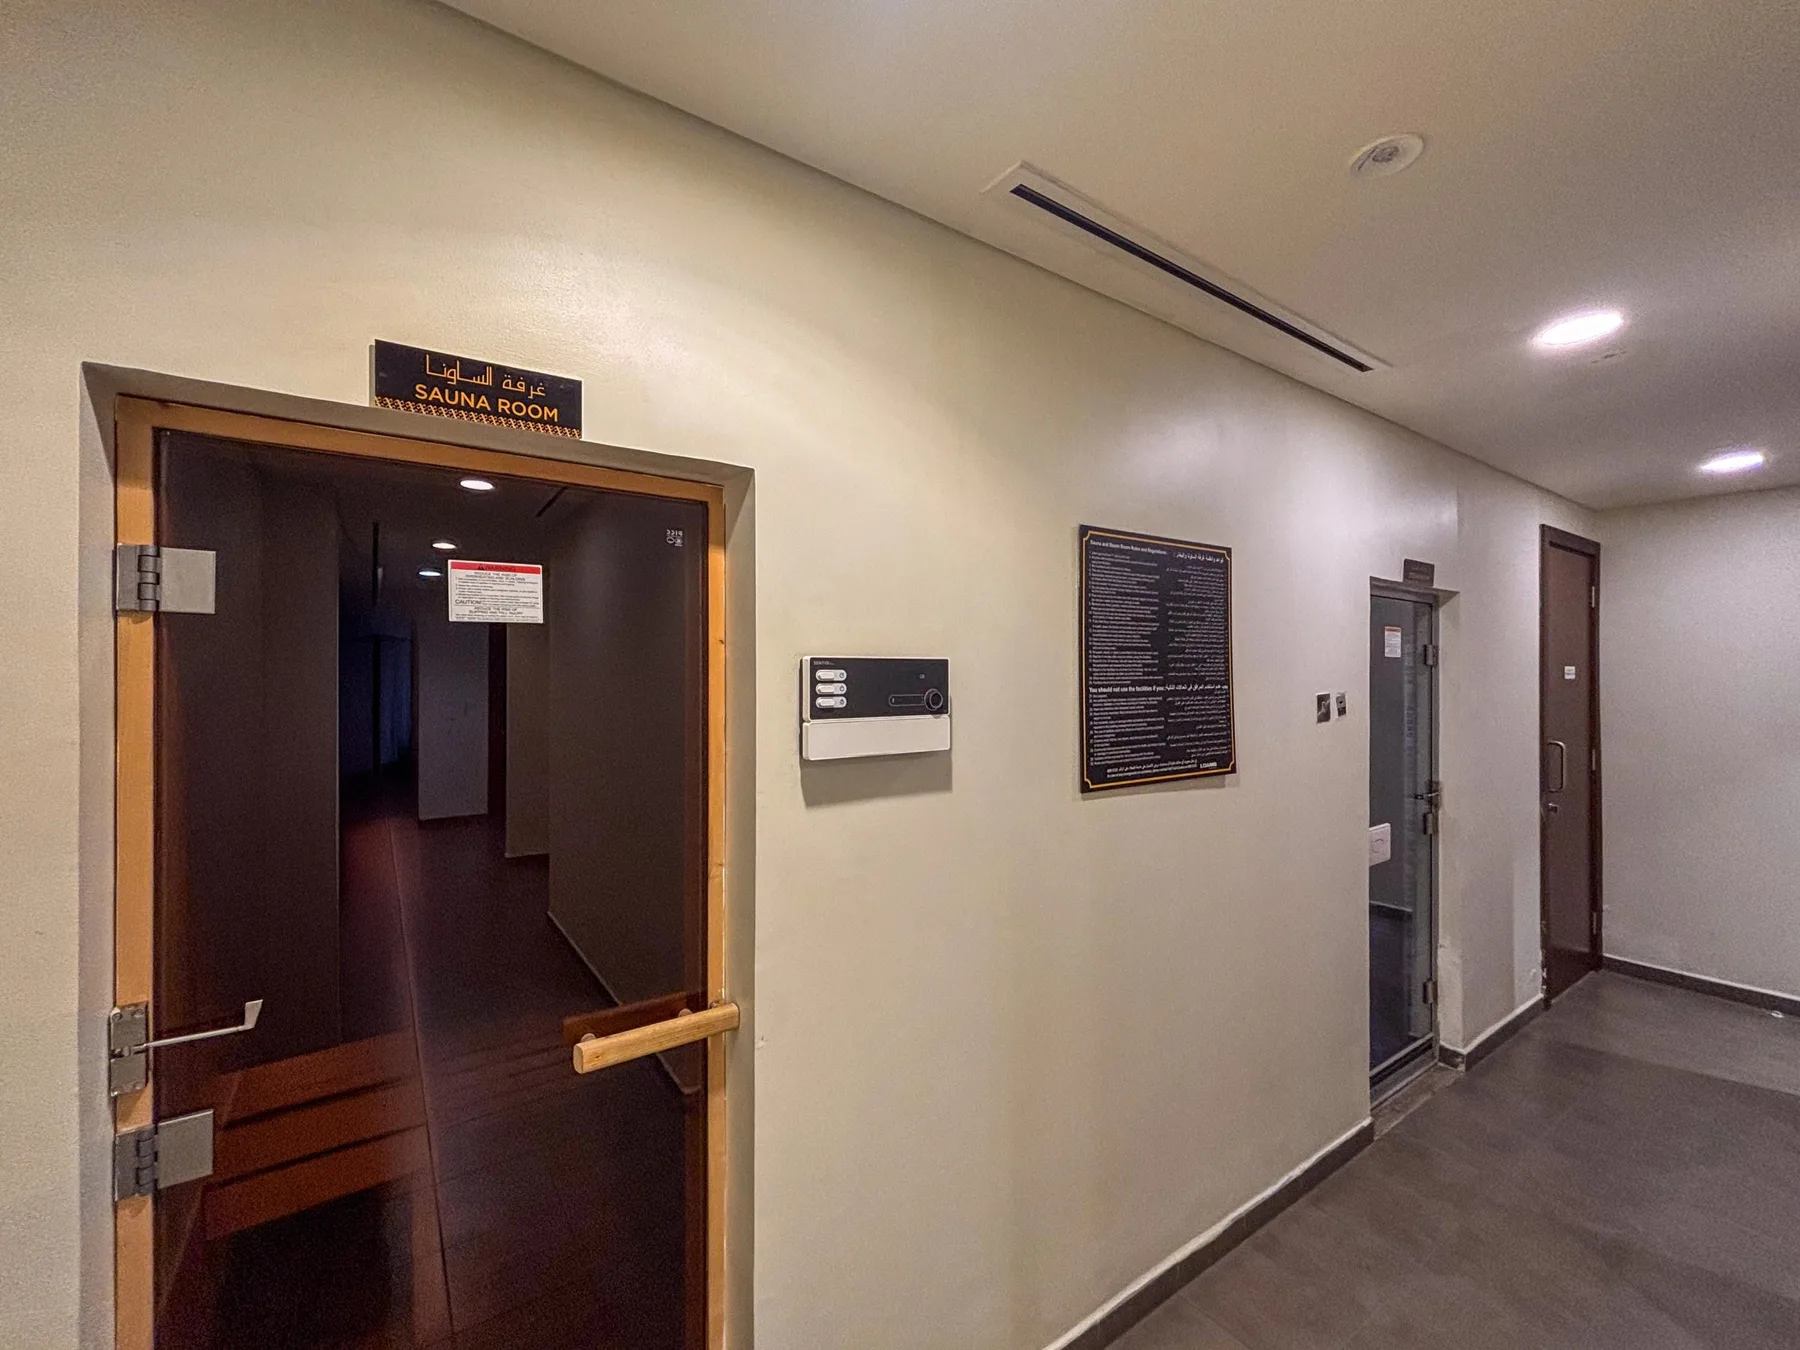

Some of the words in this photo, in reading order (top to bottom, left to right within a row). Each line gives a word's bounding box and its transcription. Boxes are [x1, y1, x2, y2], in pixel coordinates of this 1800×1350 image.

[426, 354, 493, 387] الساونا
[502, 374, 546, 399] غرفة
[415, 383, 491, 411] SAUNA
[497, 398, 558, 423] ROOM
